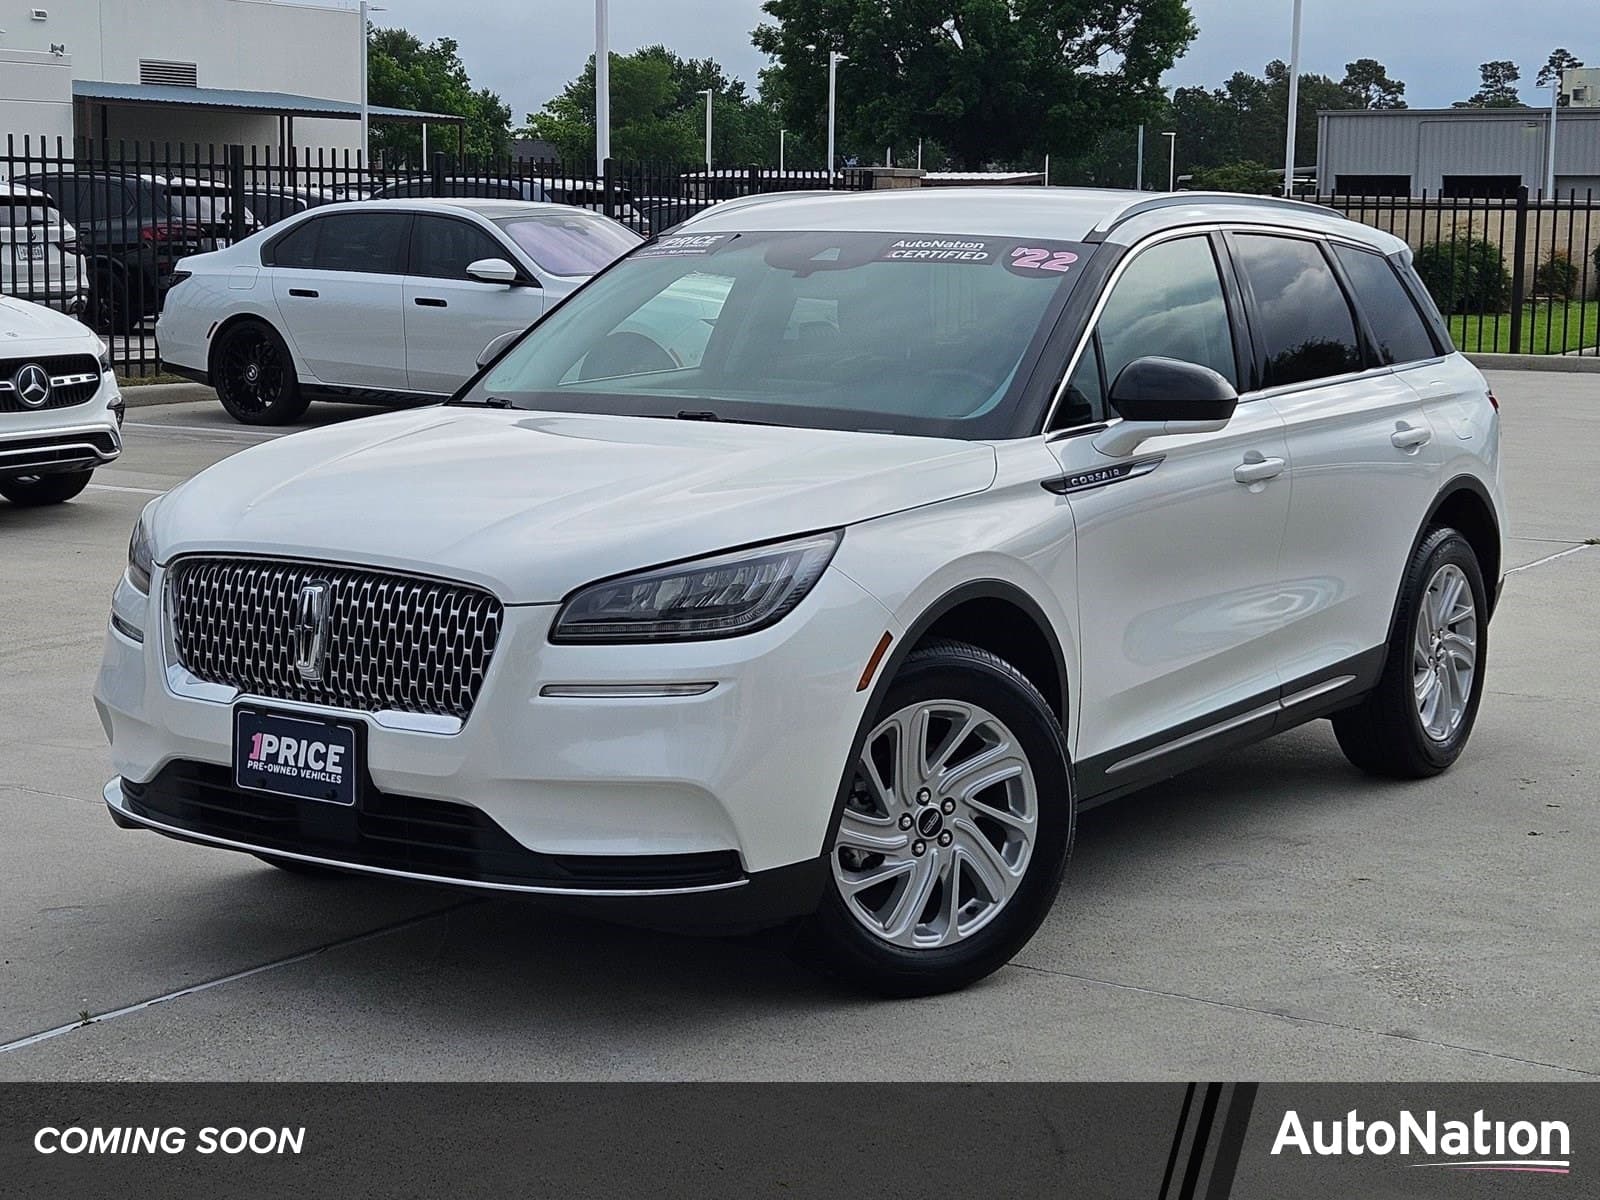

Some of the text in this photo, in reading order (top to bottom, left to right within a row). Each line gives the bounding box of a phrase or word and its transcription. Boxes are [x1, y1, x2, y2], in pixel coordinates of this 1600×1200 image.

[892, 240, 984, 249] AutoNation
[892, 249, 988, 260] CERTIFIED
[1010, 247, 1078, 272] '22
[1071, 469, 1120, 486] CORSAIR
[249, 732, 345, 774] 1PRICE
[247, 760, 342, 784] PRE-OWNED VEHICLES
